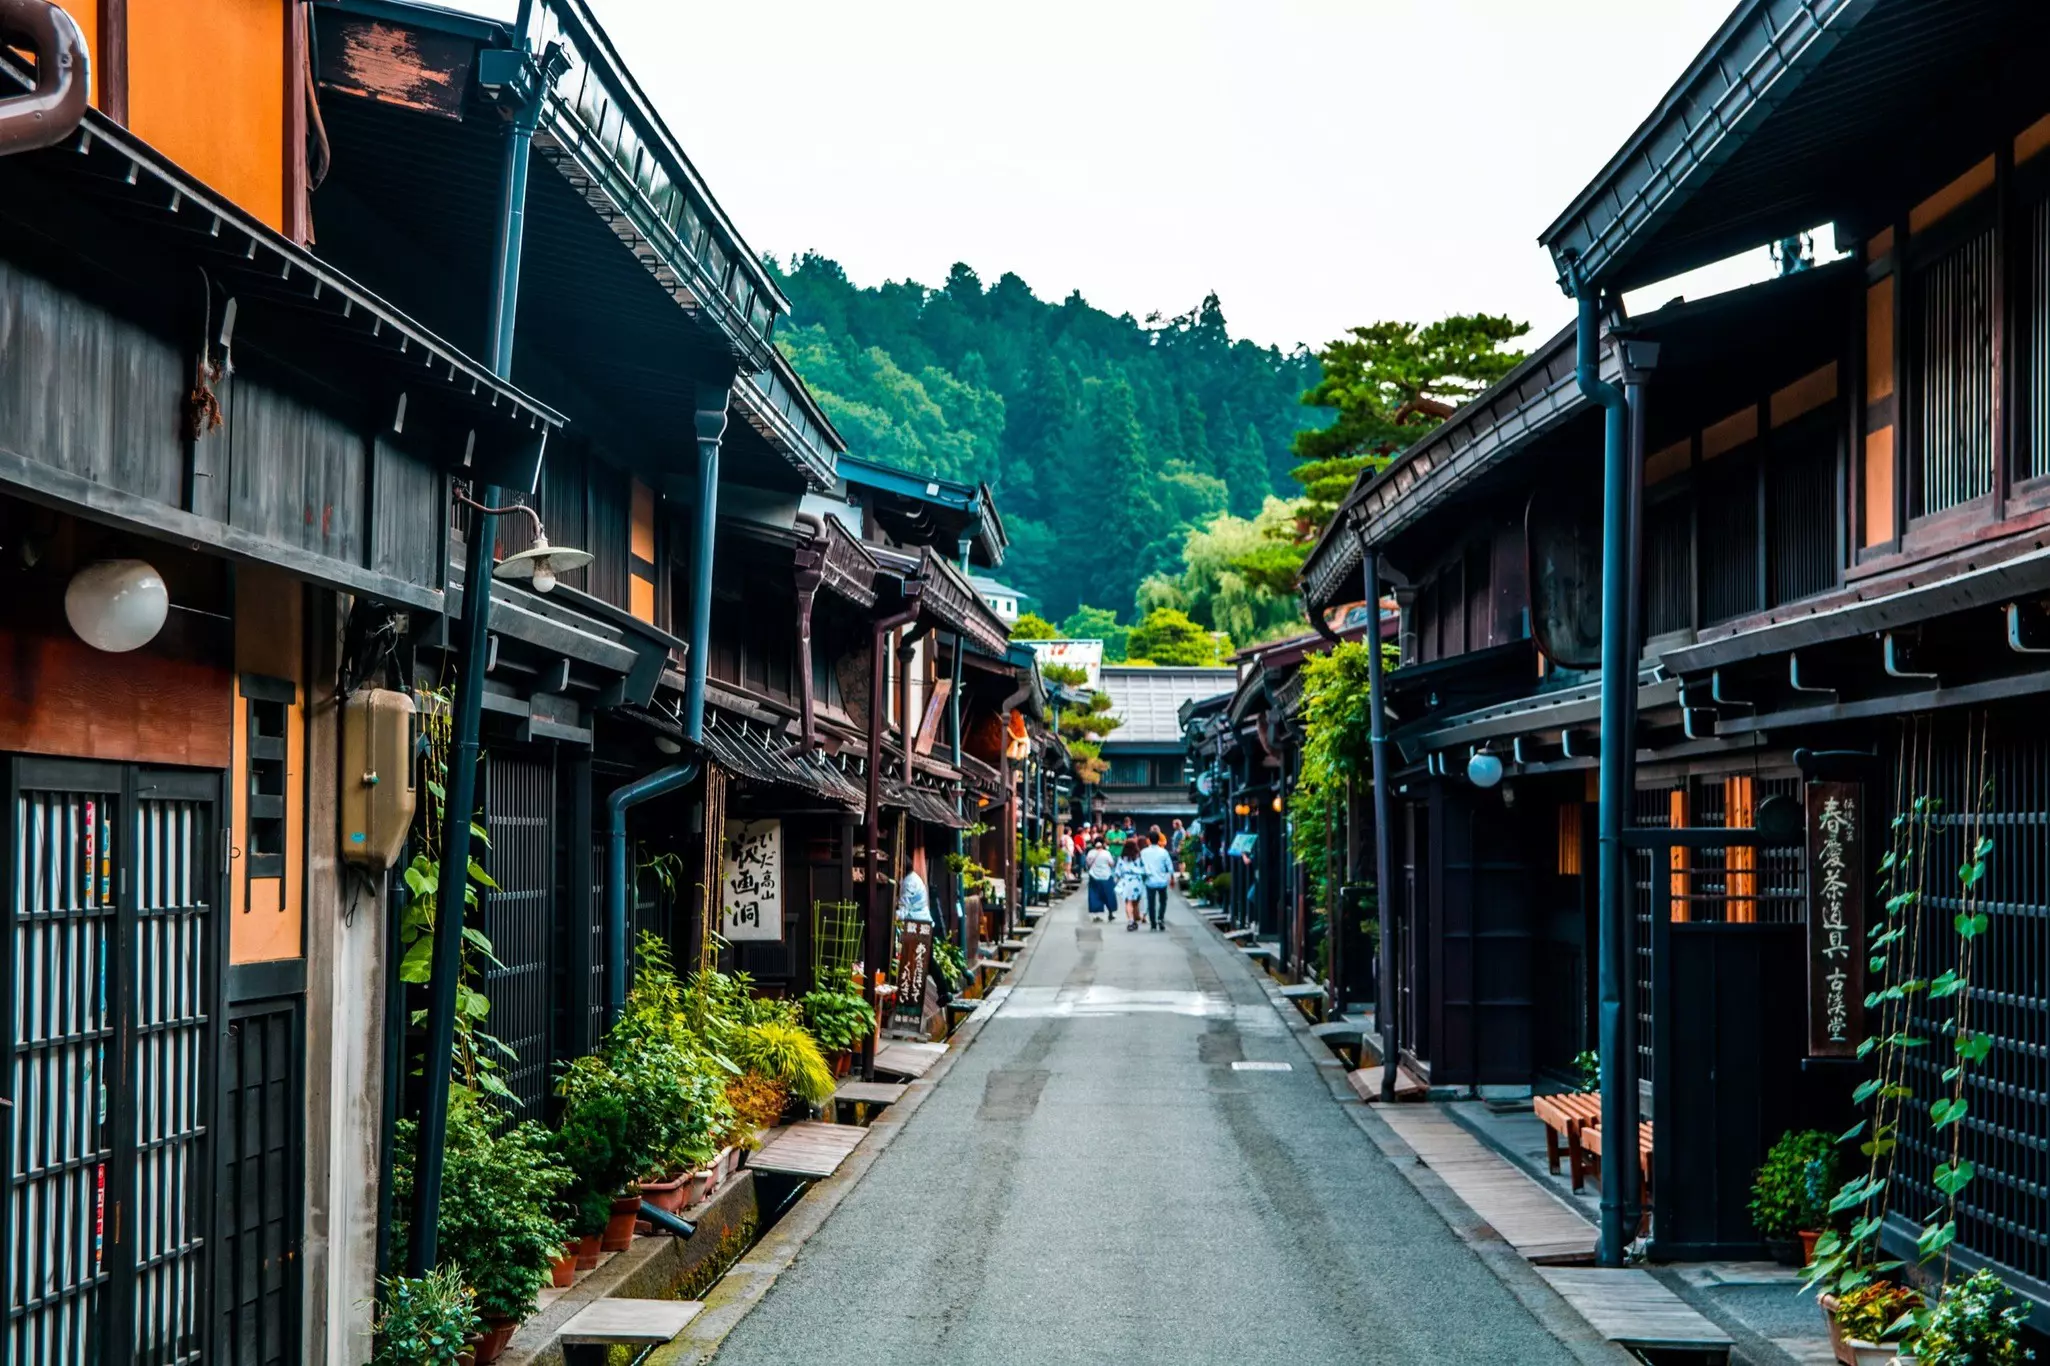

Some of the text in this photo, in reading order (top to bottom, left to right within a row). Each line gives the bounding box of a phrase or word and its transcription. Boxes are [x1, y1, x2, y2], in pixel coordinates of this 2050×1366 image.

[1819, 796, 1850, 959] 春慶茶道具
